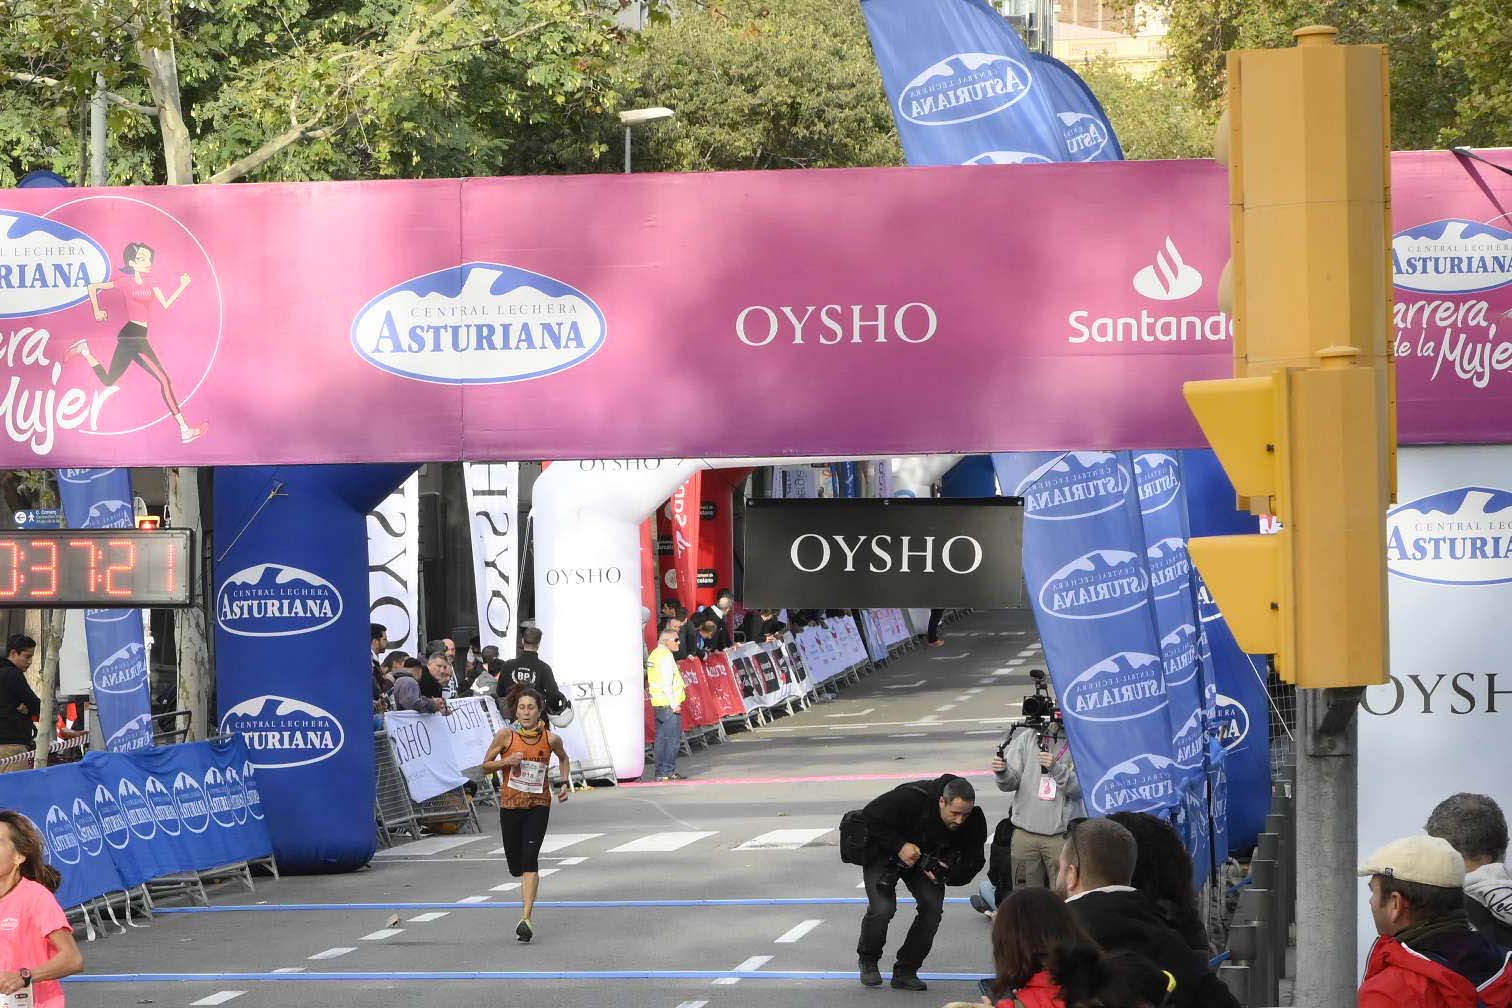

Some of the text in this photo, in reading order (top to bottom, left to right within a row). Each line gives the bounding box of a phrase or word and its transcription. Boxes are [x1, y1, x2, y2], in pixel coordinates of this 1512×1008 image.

[14, 245, 86, 257] LECHERA
[410, 303, 578, 317] CENTRAL LECHERA
[1393, 299, 1490, 329] arrera
[370, 309, 586, 355] ASTURIANA
[735, 302, 938, 347] OYSHO
[1416, 329, 1435, 357] la
[1415, 521, 1482, 532] CENTRAL
[790, 533, 983, 574] OYSHO
[545, 566, 622, 586] OYSHO
[233, 587, 329, 598] CENTRAL LECHERA
[220, 592, 334, 621] ASTURIANA
[576, 679, 624, 698] SHO
[235, 719, 330, 729] CENTRAL LECHERA
